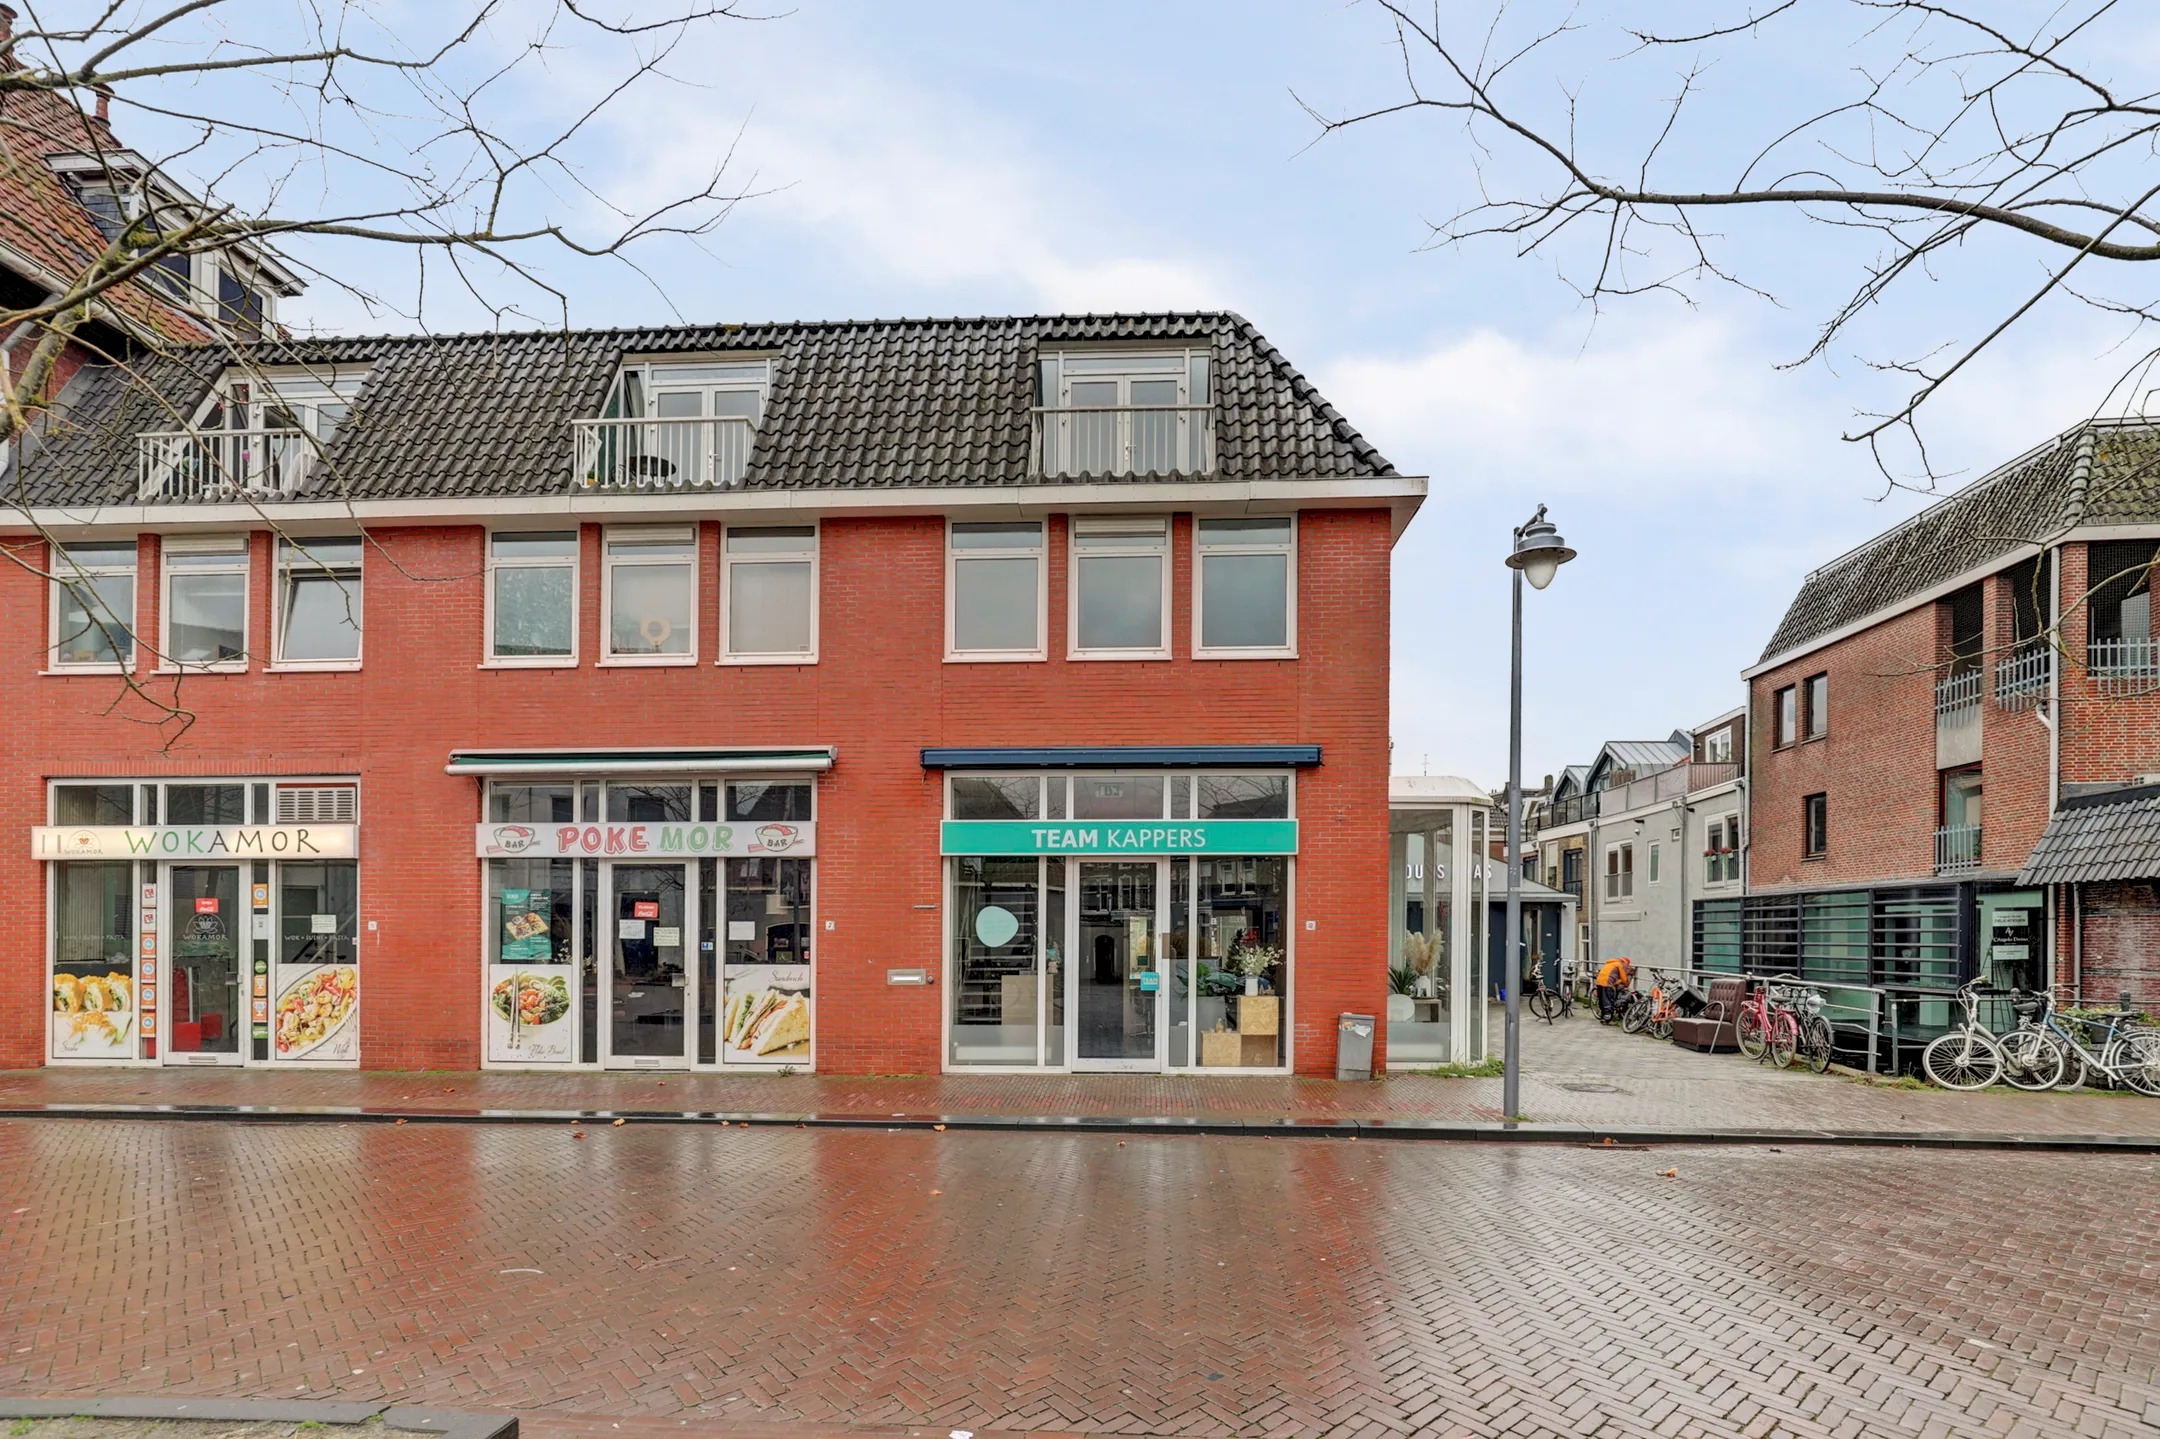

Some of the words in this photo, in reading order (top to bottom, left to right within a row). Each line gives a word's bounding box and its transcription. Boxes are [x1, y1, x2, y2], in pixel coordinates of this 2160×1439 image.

[124, 828, 320, 854] WOKAMOR
[504, 839, 526, 849] BAR
[556, 826, 649, 854] POKE
[659, 826, 734, 853] MOR
[767, 839, 788, 848] BAR
[1031, 829, 1098, 848] TEAM
[1107, 829, 1206, 848] KAPPERS
